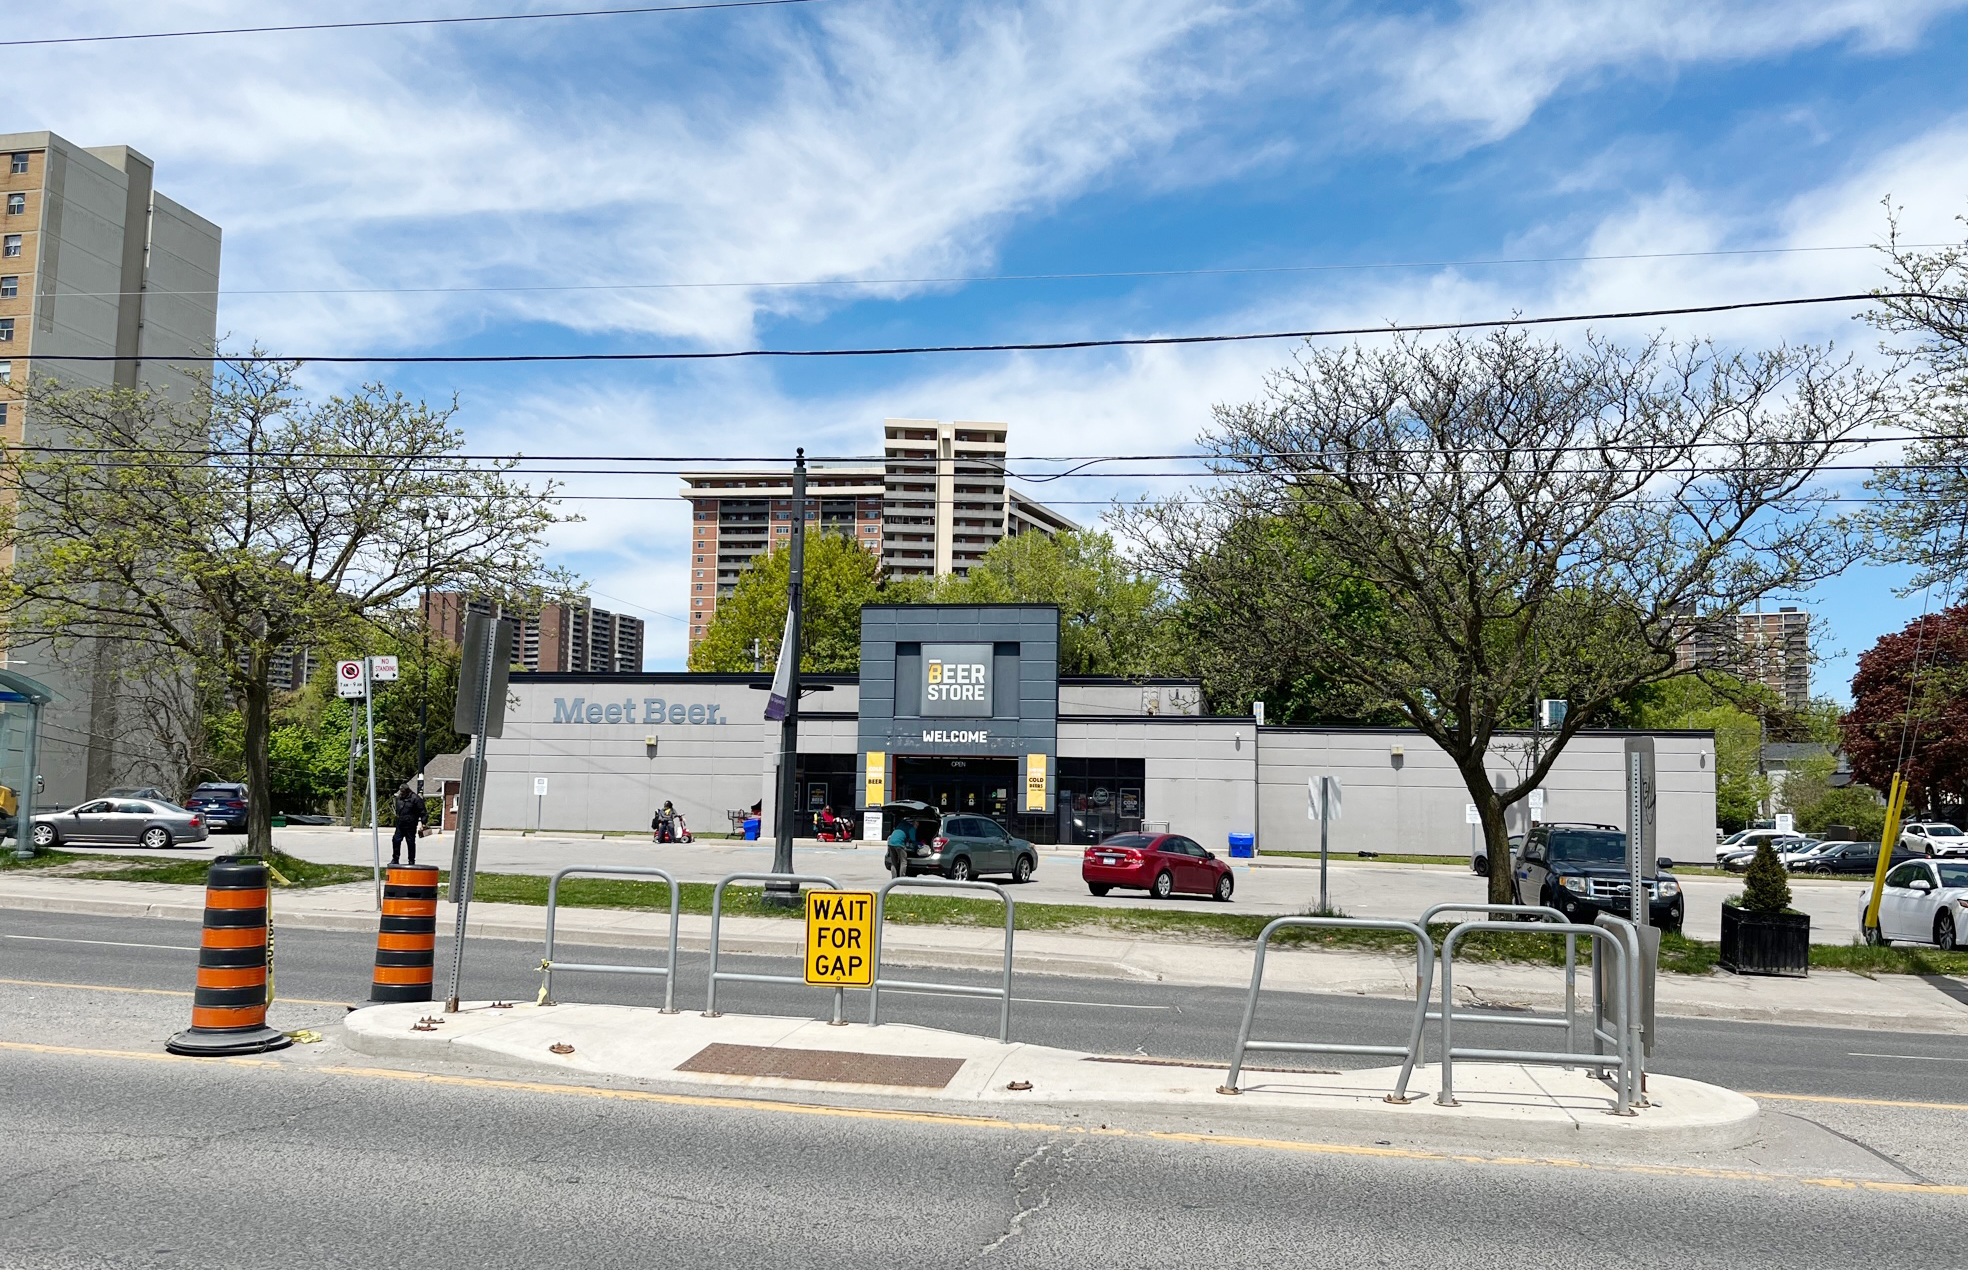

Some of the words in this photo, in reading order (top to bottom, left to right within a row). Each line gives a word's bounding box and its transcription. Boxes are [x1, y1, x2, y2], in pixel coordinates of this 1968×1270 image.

[928, 661, 986, 684] BEER
[928, 684, 985, 701] STORE
[553, 697, 636, 724] Meet
[642, 698, 727, 725] Beer.
[922, 730, 988, 743] WELCOME
[813, 899, 868, 921] WAIT
[817, 927, 861, 949] FOR
[815, 954, 863, 976] GAP
